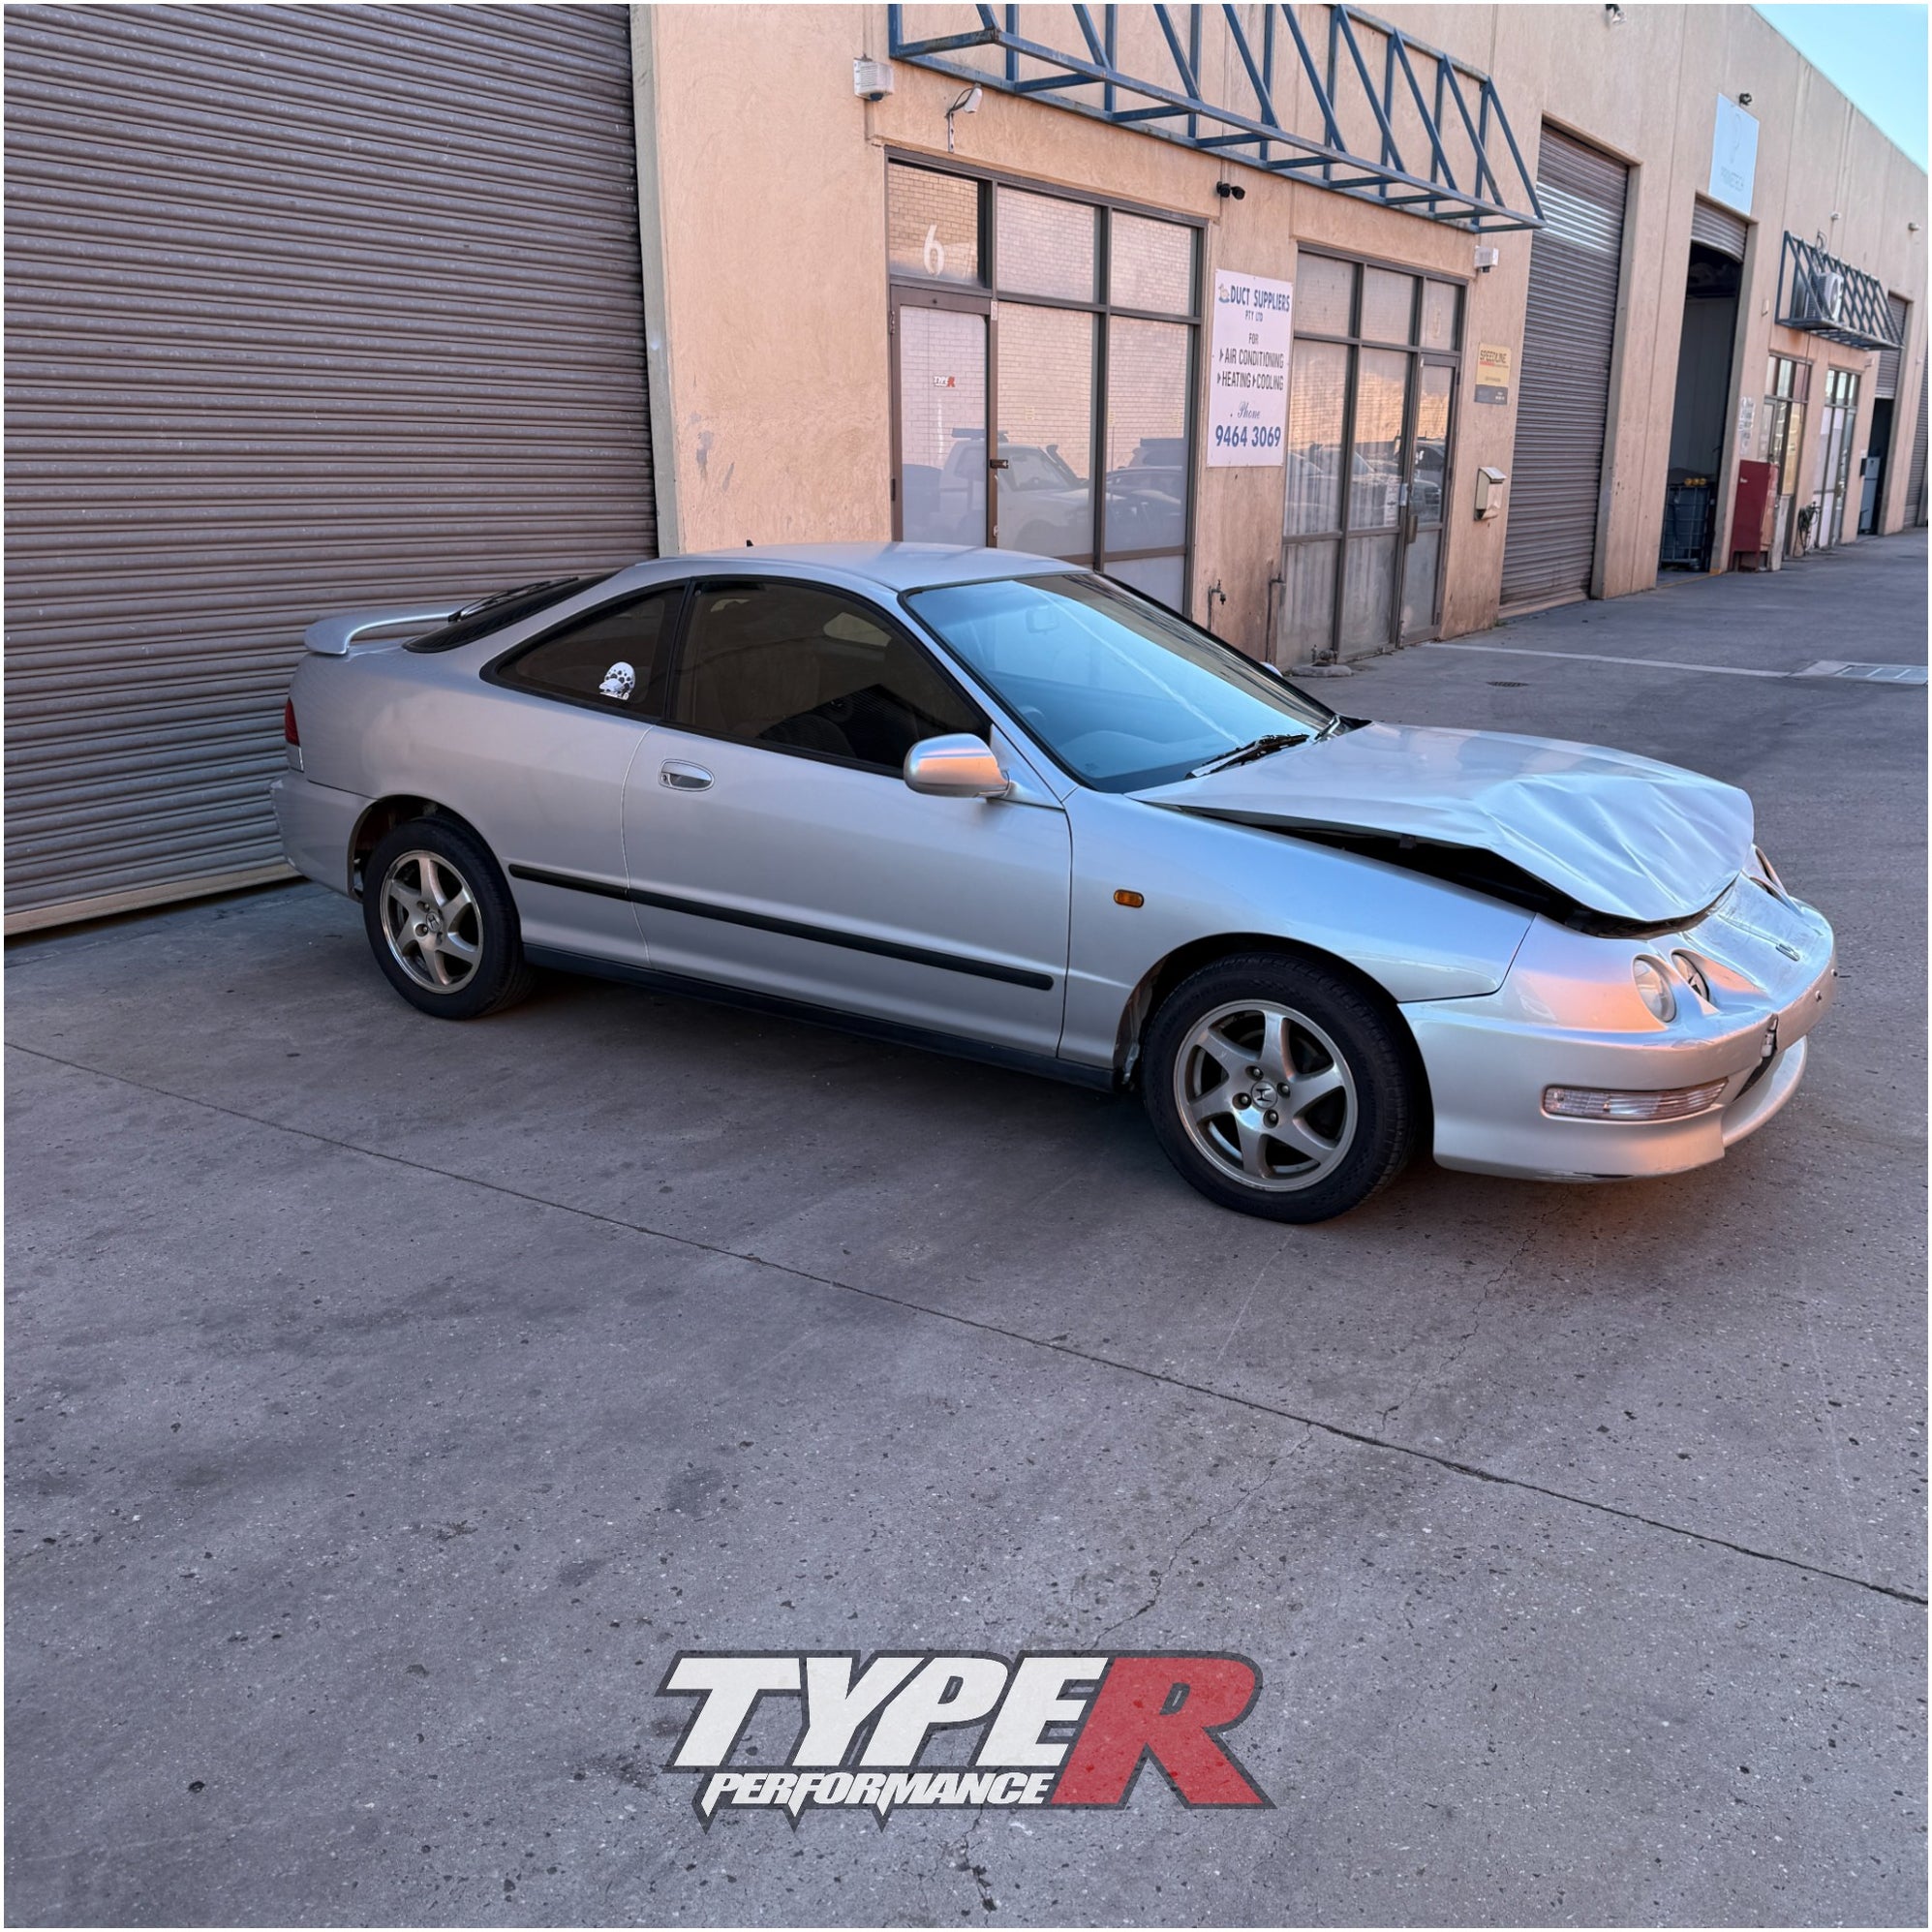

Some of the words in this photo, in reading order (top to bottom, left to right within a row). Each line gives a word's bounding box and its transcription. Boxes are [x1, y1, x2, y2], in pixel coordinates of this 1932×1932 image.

[923, 224, 945, 277] 6
[1230, 285, 1250, 307] DUCT
[1253, 289, 1290, 313] SUPPLIERS
[1244, 310, 1254, 321] PTY
[1248, 332, 1259, 345] FOR
[1224, 349, 1237, 364] AIR
[1239, 351, 1284, 369] CONDITIONING
[1221, 370, 1251, 388] HEATING
[1256, 374, 1283, 390] COOLING
[1237, 401, 1261, 419] Phone
[1215, 424, 1247, 447] 9464
[1251, 425, 1281, 447] 3069
